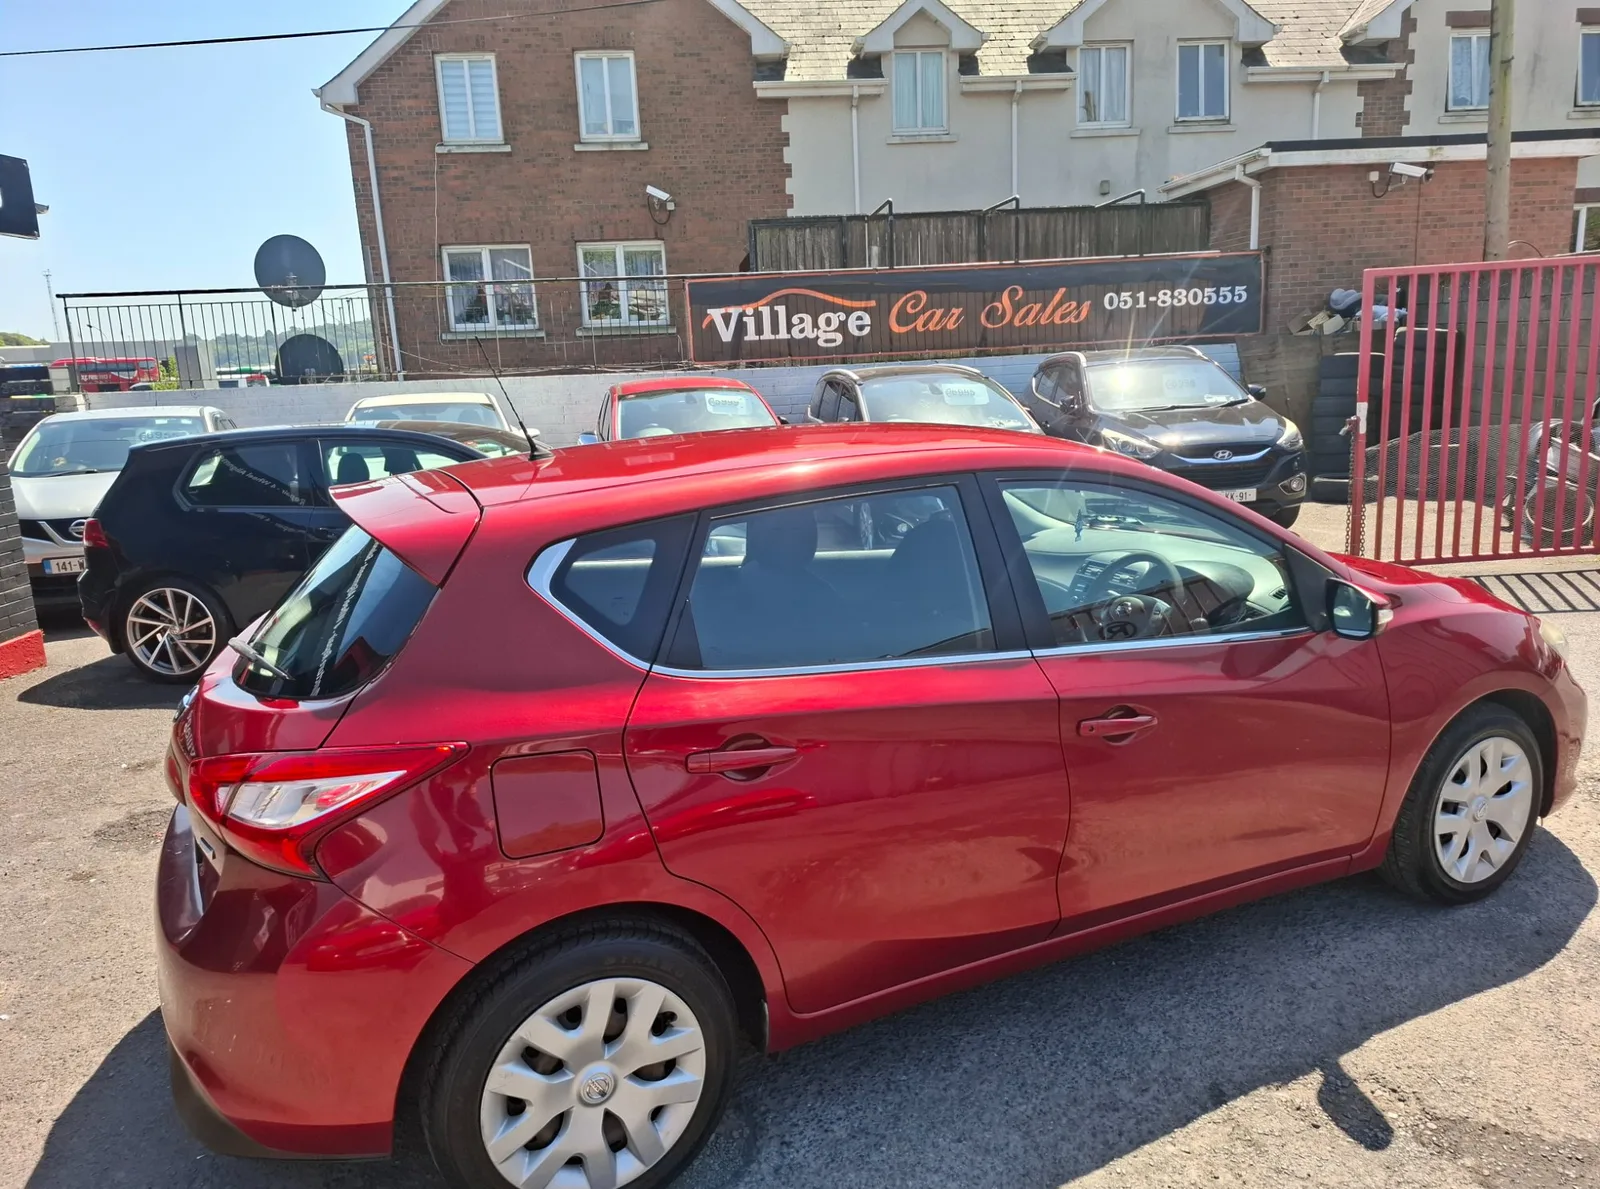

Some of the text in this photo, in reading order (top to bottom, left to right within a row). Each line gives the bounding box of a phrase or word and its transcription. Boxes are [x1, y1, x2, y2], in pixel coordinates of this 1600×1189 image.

[706, 285, 1248, 347] Village Car Sales 051-830555
